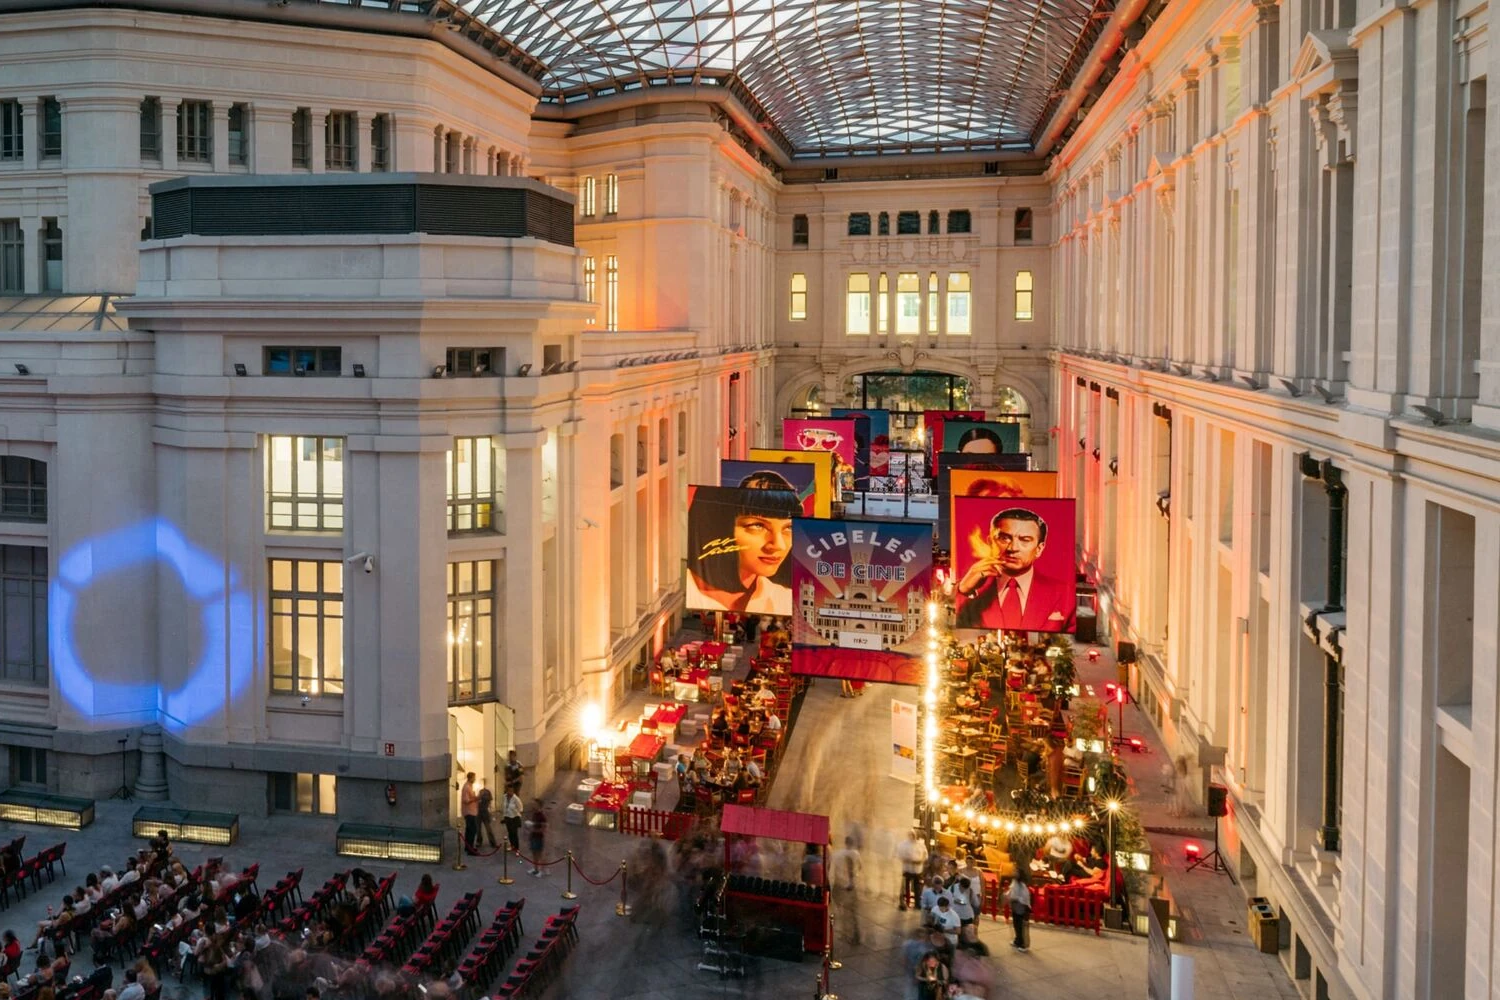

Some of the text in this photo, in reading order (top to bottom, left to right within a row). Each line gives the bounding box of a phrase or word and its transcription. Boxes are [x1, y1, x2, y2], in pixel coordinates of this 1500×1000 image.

[806, 530, 917, 563] CIBELES
[816, 560, 906, 582] DE CINE
